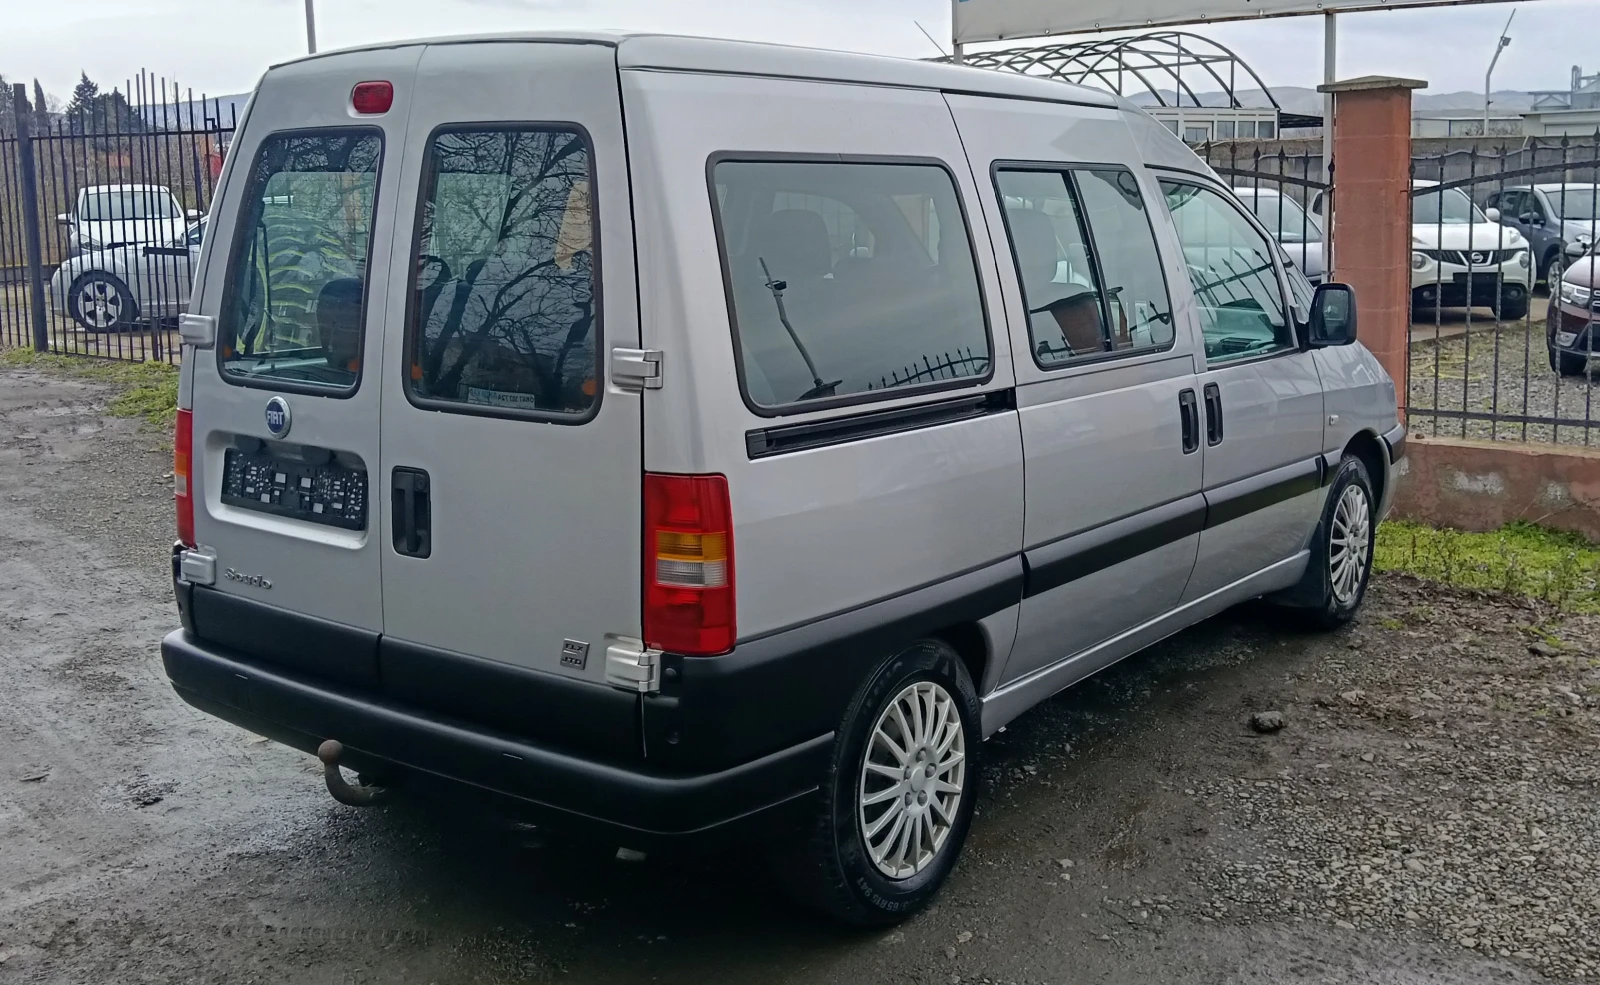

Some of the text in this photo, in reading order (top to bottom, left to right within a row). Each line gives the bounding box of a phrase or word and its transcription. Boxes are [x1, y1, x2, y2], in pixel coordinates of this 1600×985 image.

[267, 411, 284, 425] FIAT
[225, 567, 272, 589] Scudo
[562, 656, 582, 666] JTD
